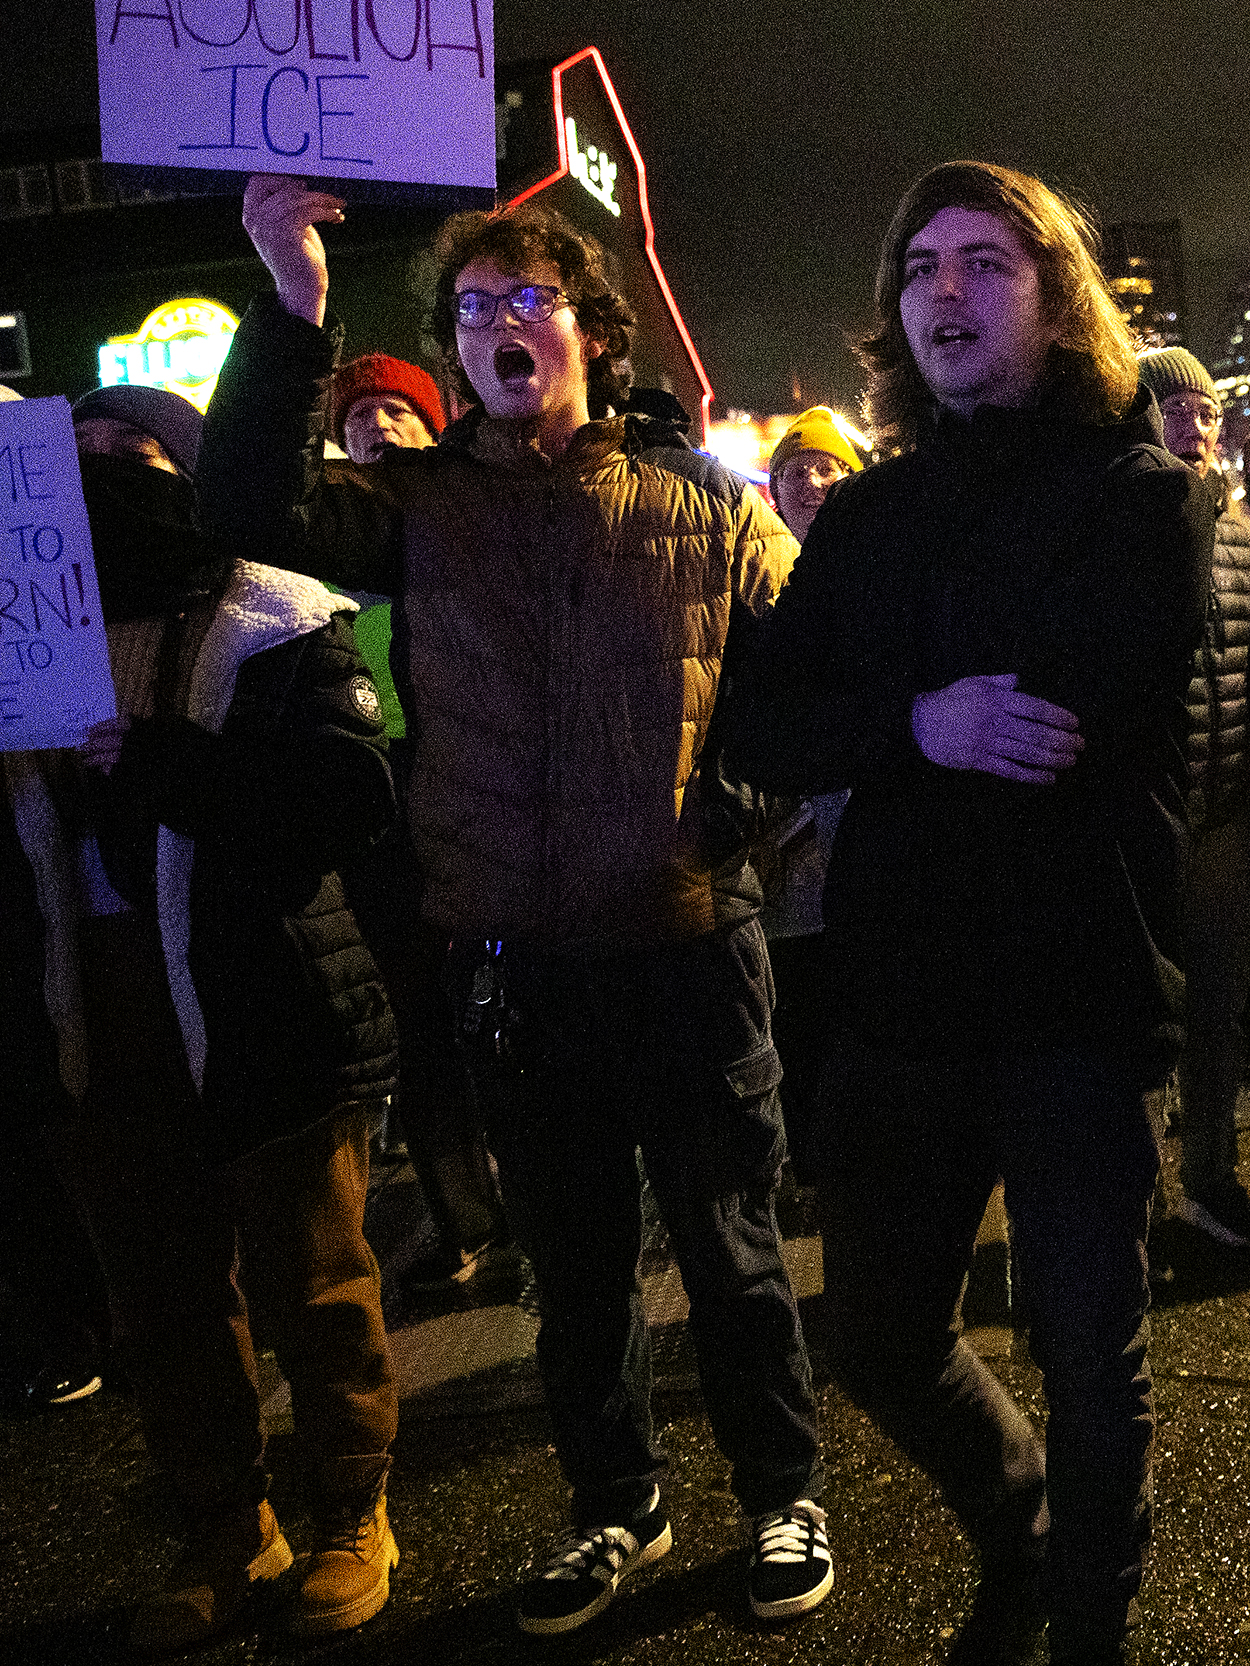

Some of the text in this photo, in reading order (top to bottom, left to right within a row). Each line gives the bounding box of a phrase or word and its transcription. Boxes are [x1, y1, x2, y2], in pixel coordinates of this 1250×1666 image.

[178, 64, 374, 165] ICE
[9, 523, 64, 563] TO
[4, 639, 54, 673] TO
